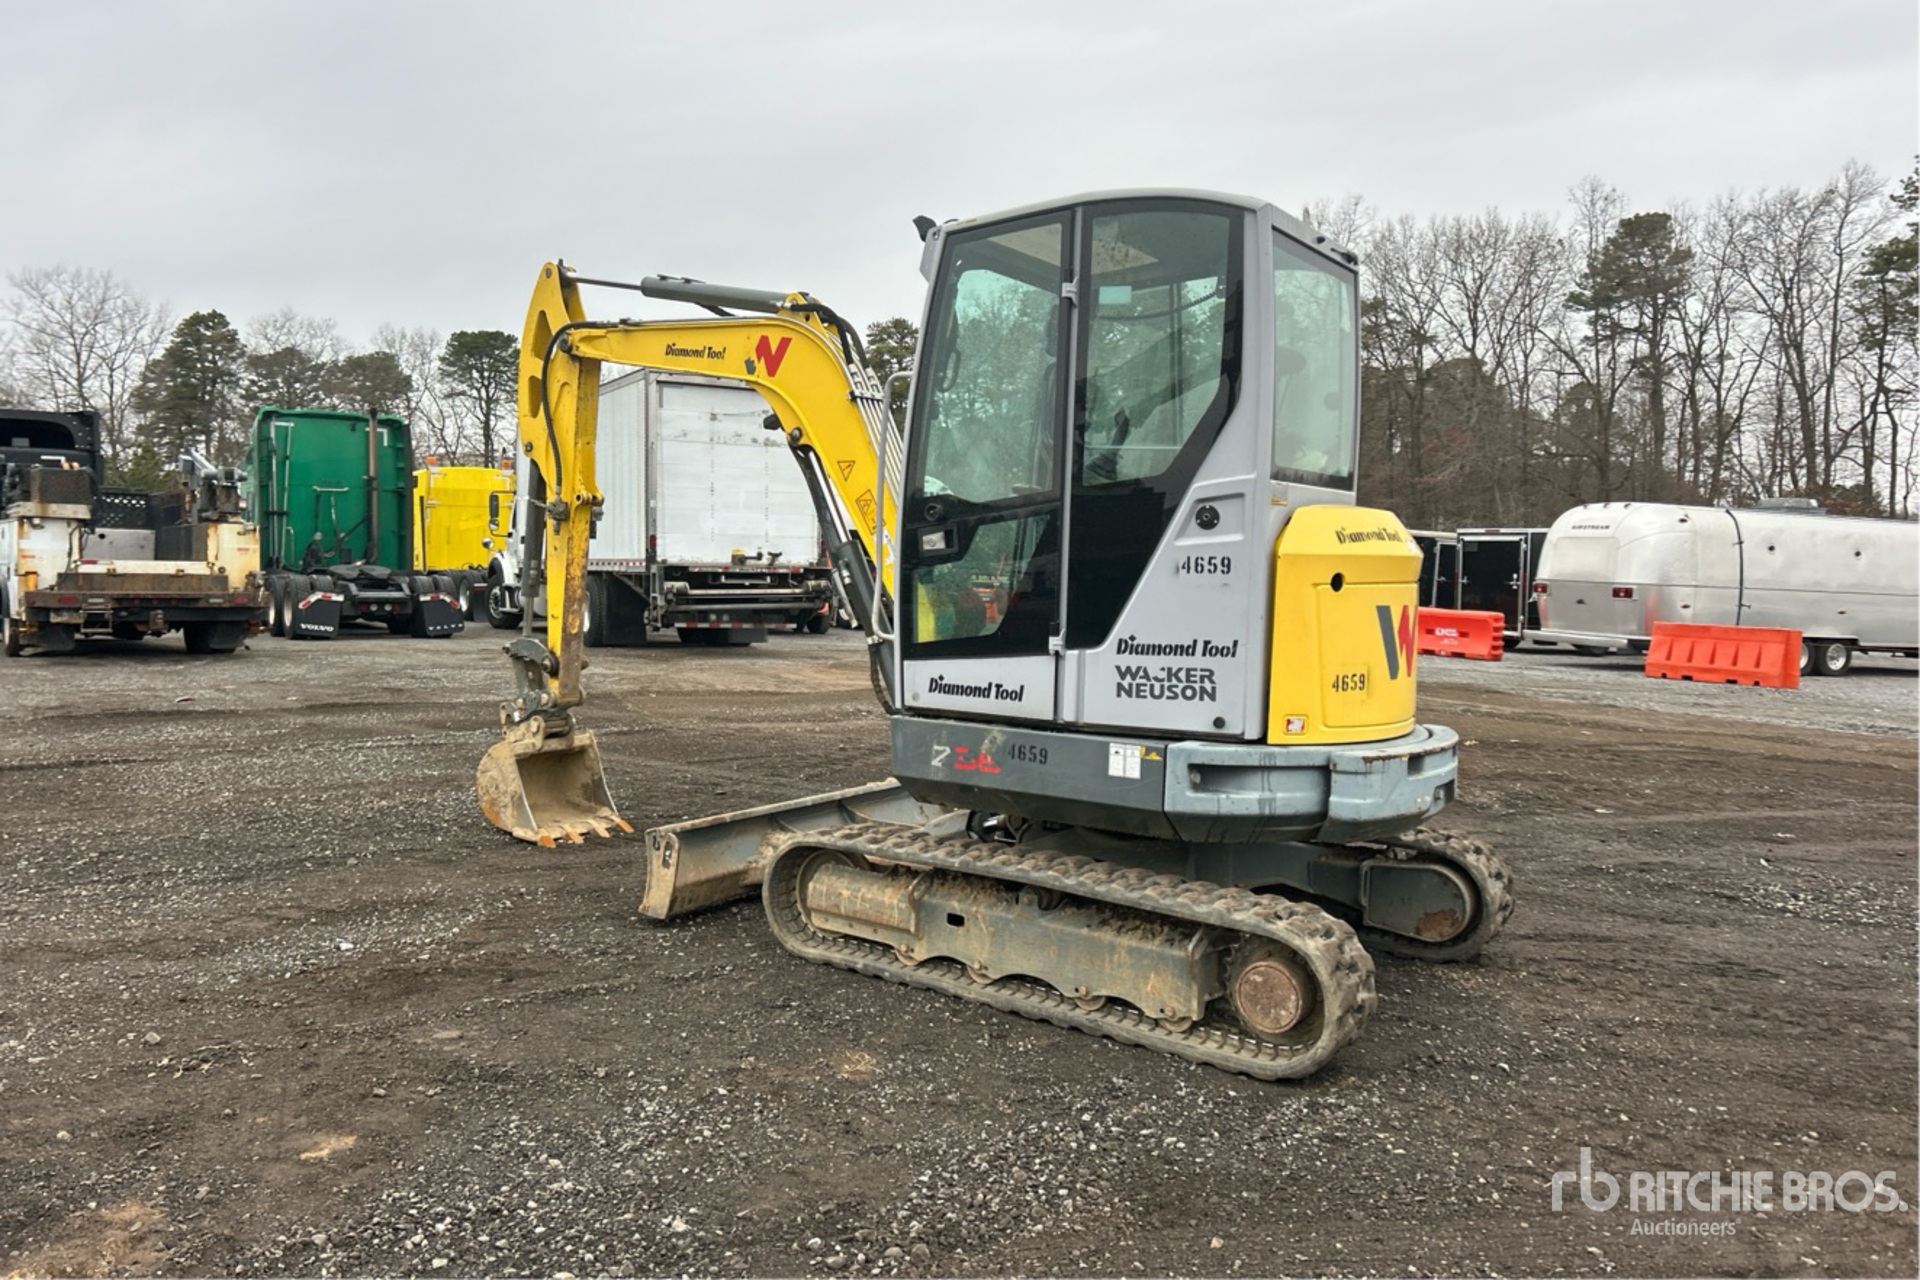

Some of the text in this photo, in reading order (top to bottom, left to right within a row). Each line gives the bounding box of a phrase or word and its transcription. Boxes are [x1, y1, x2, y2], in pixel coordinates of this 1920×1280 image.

[665, 342, 727, 360] Diamond Tool
[1335, 526, 1403, 544] Diamond Tool
[1181, 555, 1232, 575] 4659
[300, 623, 334, 632] VOLVO
[428, 623, 463, 631] VOLVO
[1116, 634, 1239, 658] Diamond Tool
[1375, 604, 1418, 681] W
[928, 674, 1025, 702] Diamond Tool
[1116, 682, 1217, 702] NEUSON
[1332, 673, 1366, 693] 4659
[1007, 743, 1049, 765] 4659
